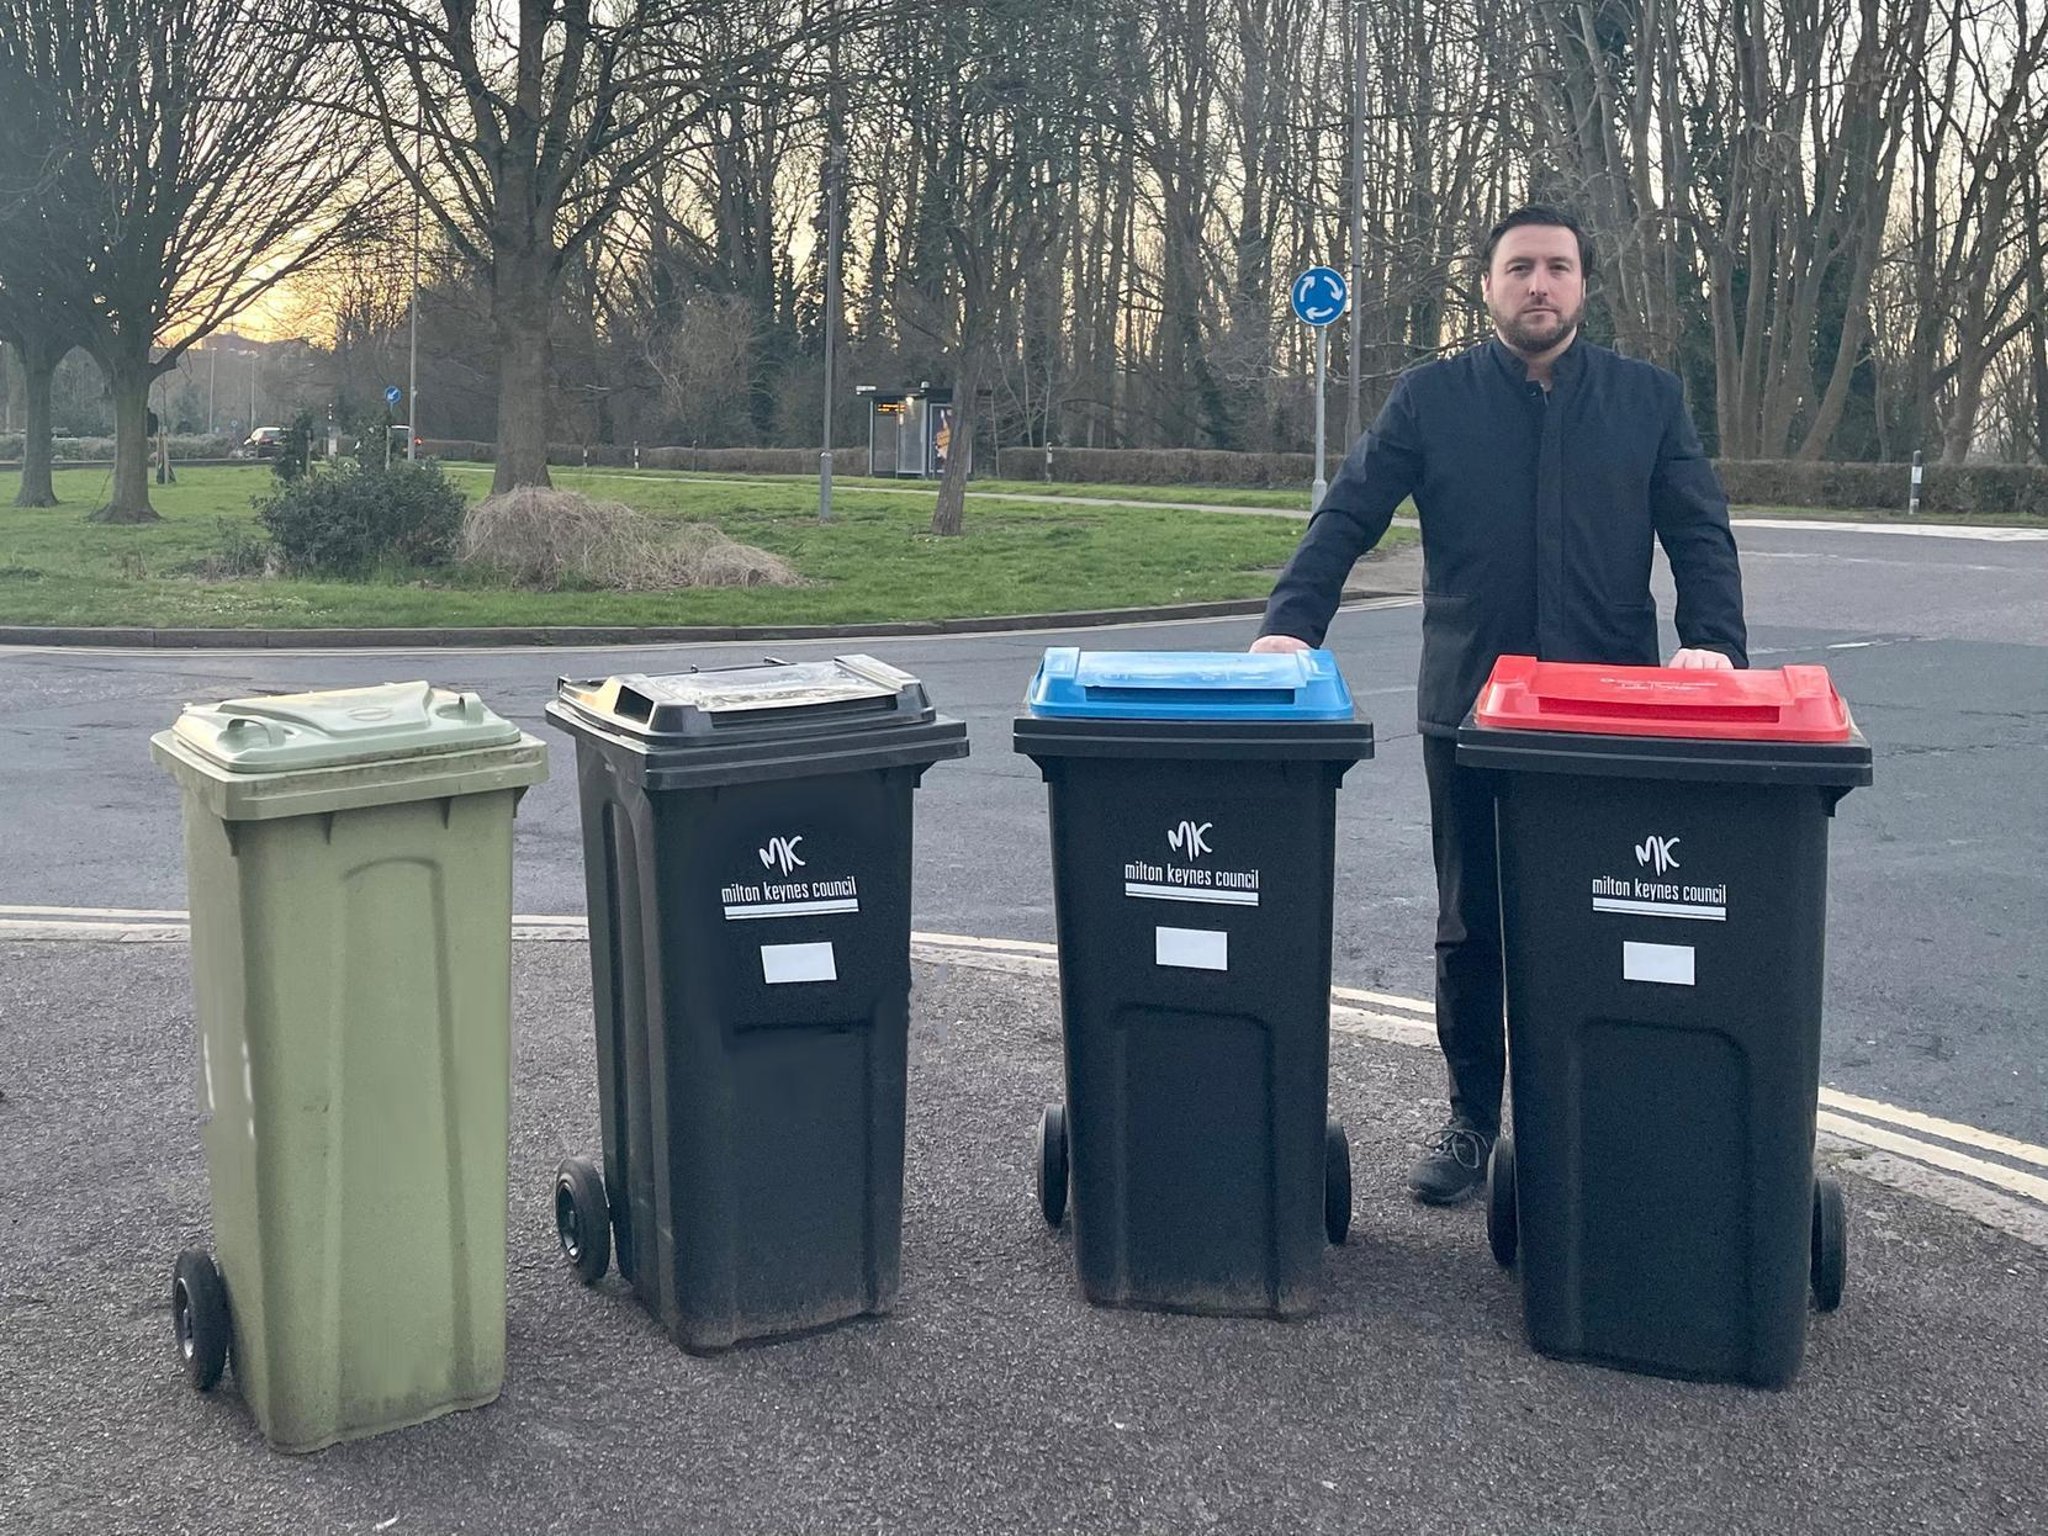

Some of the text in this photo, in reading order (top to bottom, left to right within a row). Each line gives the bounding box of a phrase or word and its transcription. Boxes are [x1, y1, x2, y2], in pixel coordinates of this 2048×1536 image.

[758, 835, 806, 877] MK
[1167, 820, 1213, 862] MK
[1635, 835, 1681, 877] MK
[721, 876, 857, 903] milton keynes council
[1125, 860, 1259, 889] milton keynes council
[1592, 875, 1727, 904] milton keynes council
